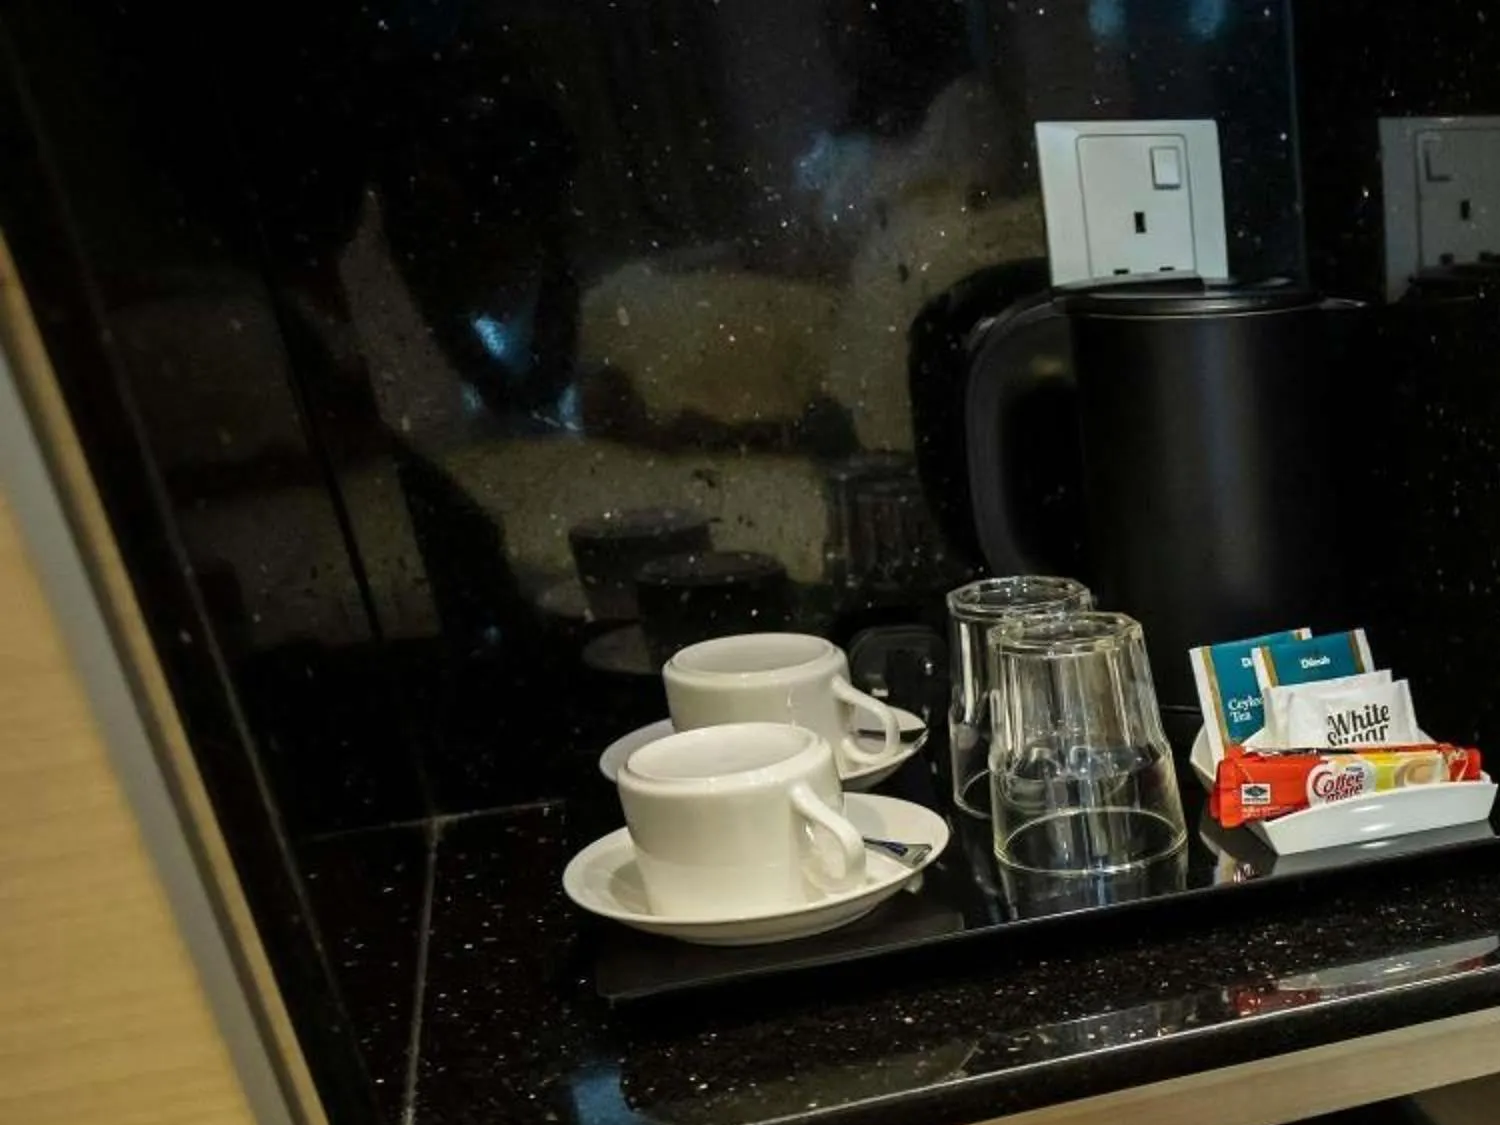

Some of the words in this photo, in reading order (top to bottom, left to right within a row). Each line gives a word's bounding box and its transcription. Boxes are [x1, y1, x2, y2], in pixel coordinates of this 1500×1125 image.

[1227, 694, 1264, 711] Ceylo
[1229, 710, 1253, 723] Tea
[1328, 704, 1390, 736] White
[1312, 771, 1365, 798] Coffee
